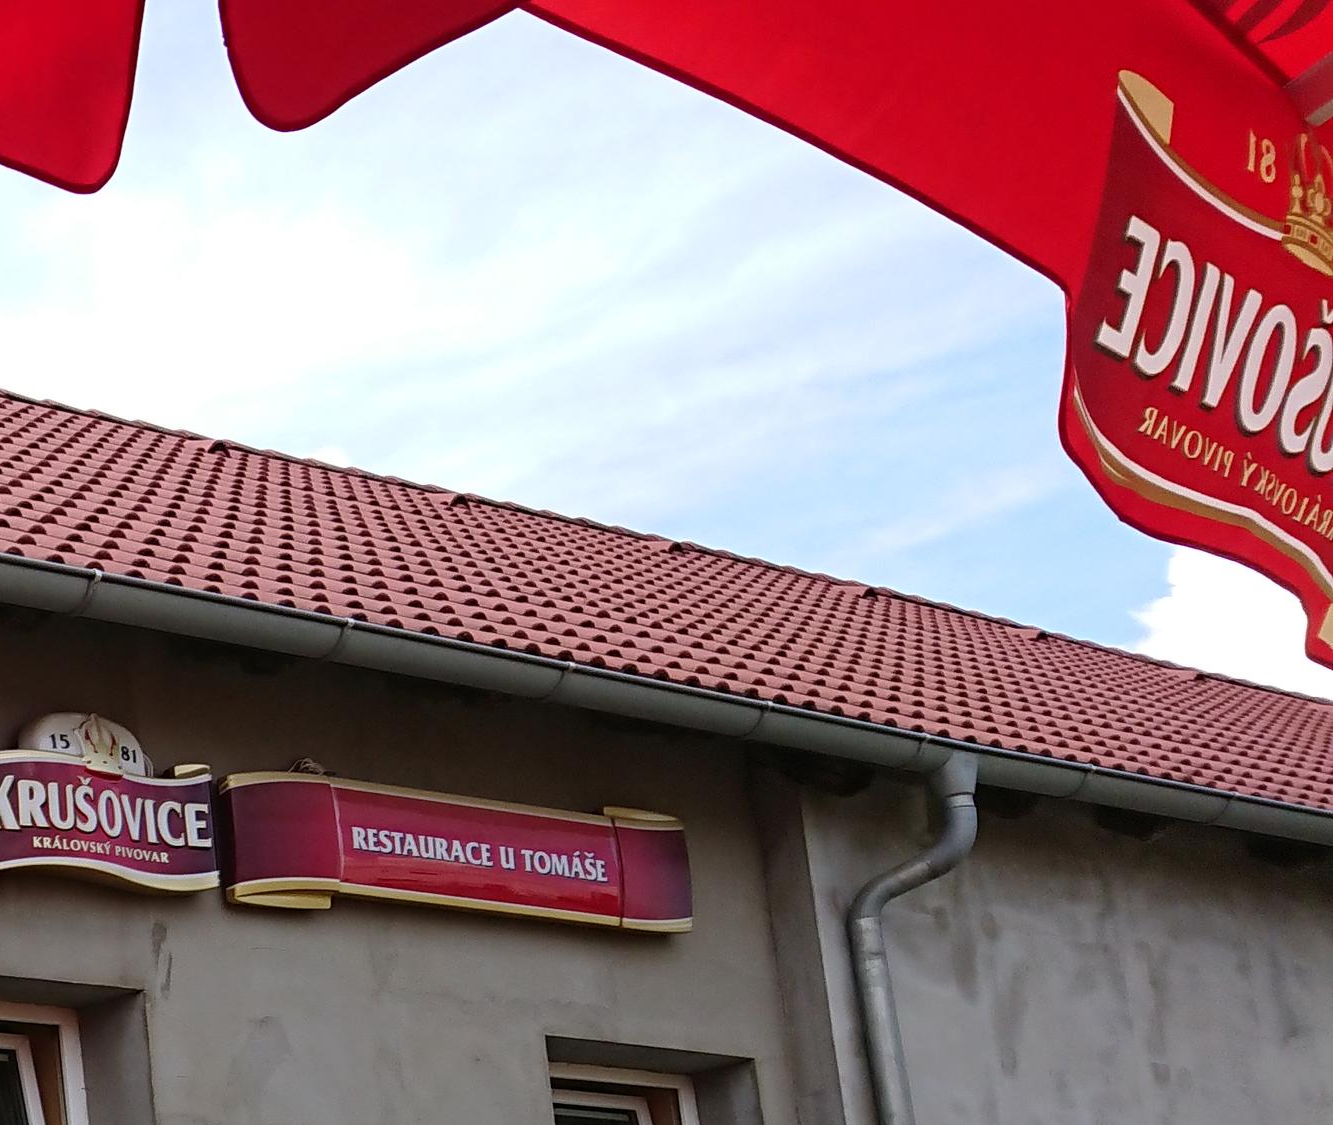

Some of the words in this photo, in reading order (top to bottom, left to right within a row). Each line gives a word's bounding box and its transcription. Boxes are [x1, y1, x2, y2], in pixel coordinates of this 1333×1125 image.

[48, 733, 70, 749] 15
[121, 745, 138, 763] 81
[33, 834, 111, 857] KRÁLOVSKÝ
[115, 845, 170, 864] PIVOVAR
[351, 826, 494, 867] RESTAURACE
[521, 849, 608, 882] TOMÁŠE
